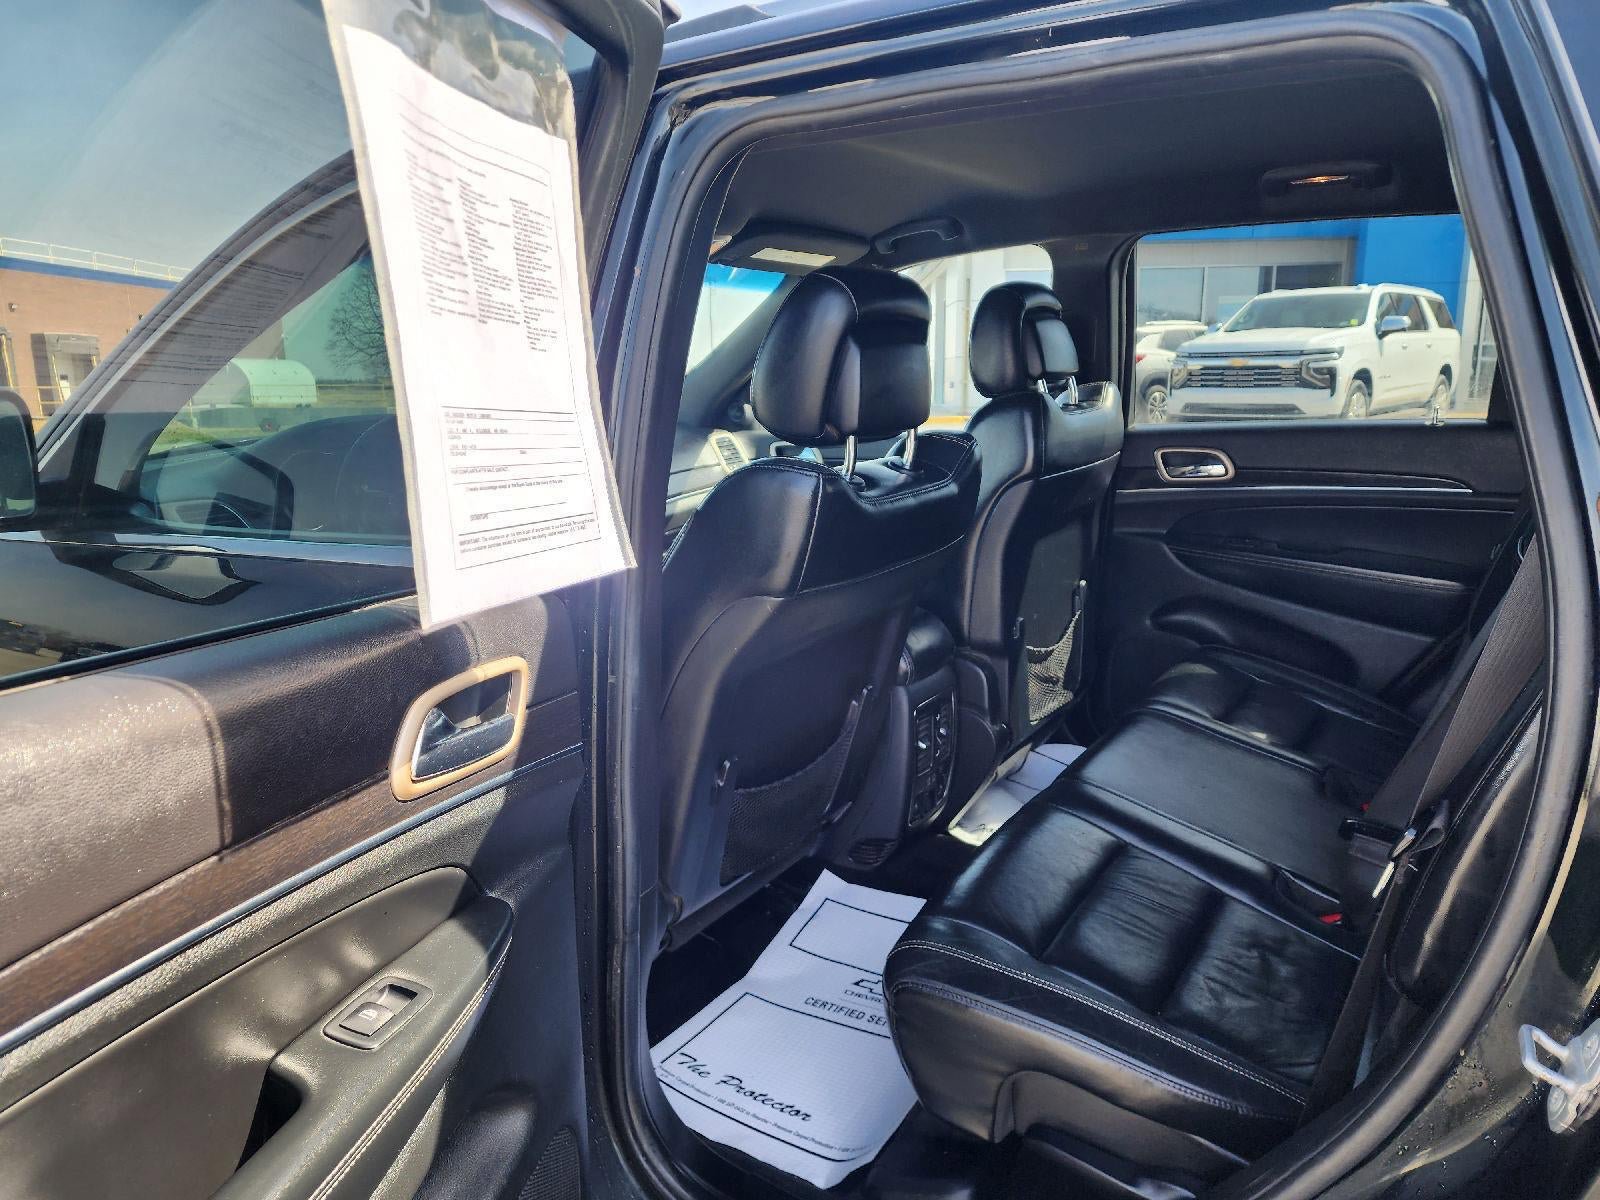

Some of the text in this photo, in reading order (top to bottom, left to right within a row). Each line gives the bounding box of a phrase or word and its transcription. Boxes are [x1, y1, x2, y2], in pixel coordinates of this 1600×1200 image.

[804, 996, 866, 1020] CERTIFIED
[677, 1053, 711, 1078] The
[715, 1075, 811, 1121] Protector
